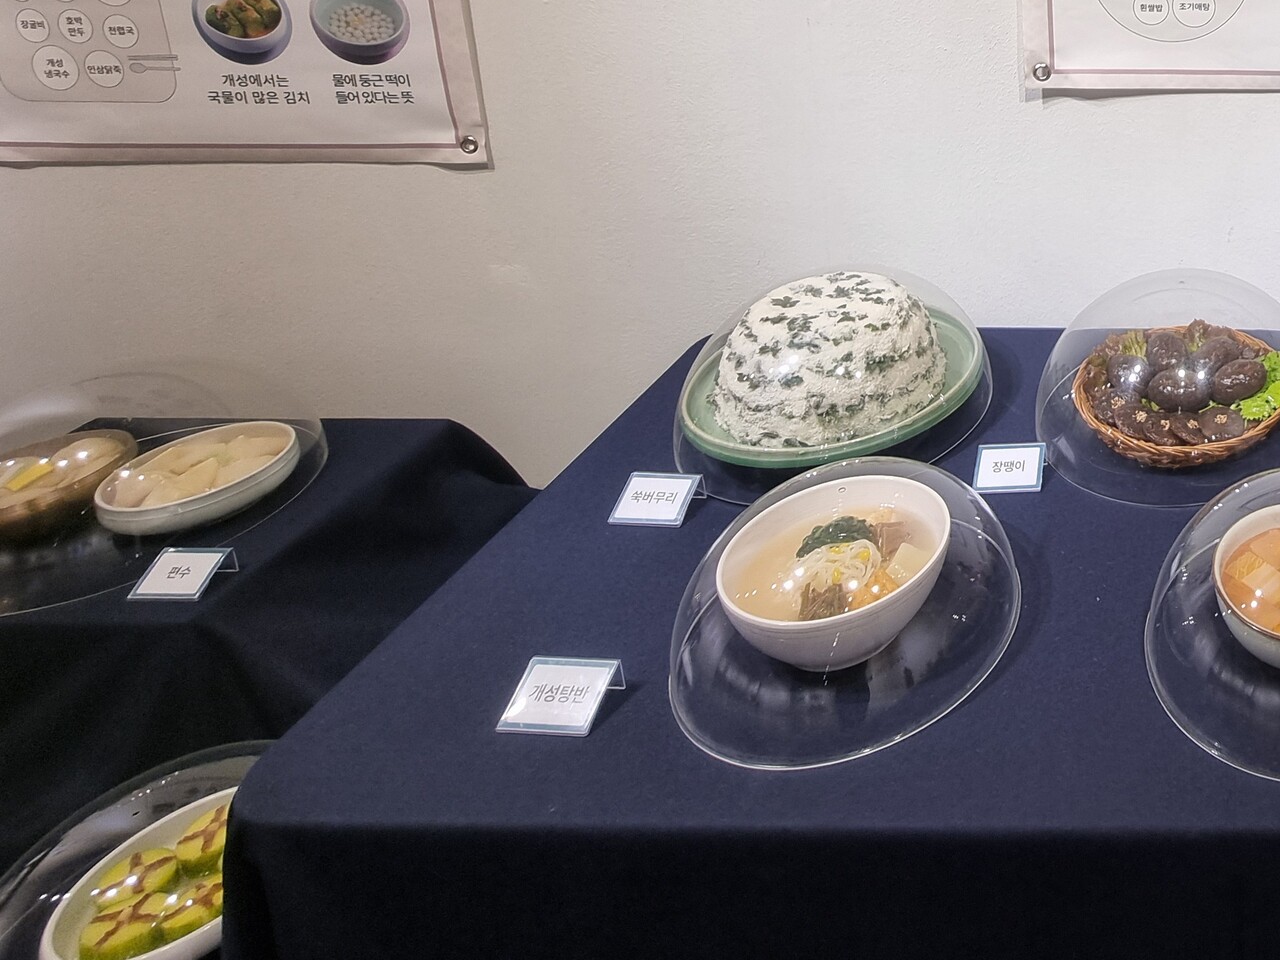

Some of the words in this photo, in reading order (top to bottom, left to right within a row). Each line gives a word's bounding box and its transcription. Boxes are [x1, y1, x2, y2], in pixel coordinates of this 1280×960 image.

[222, 74, 289, 87] 개성에서는
[332, 74, 356, 87] 물에
[359, 75, 383, 87] 둥근
[386, 75, 410, 87] 떡이
[207, 91, 247, 104] 국물이
[252, 91, 279, 104] 많은
[284, 91, 310, 104] 김치
[336, 91, 361, 104] 들어
[363, 91, 399, 104] 있다는
[401, 91, 414, 104] 뜻
[992, 460, 1025, 473] 장땡이
[631, 491, 678, 504] 쑥버무리
[167, 566, 192, 578] 편수
[529, 683, 590, 703] 개성탕반
